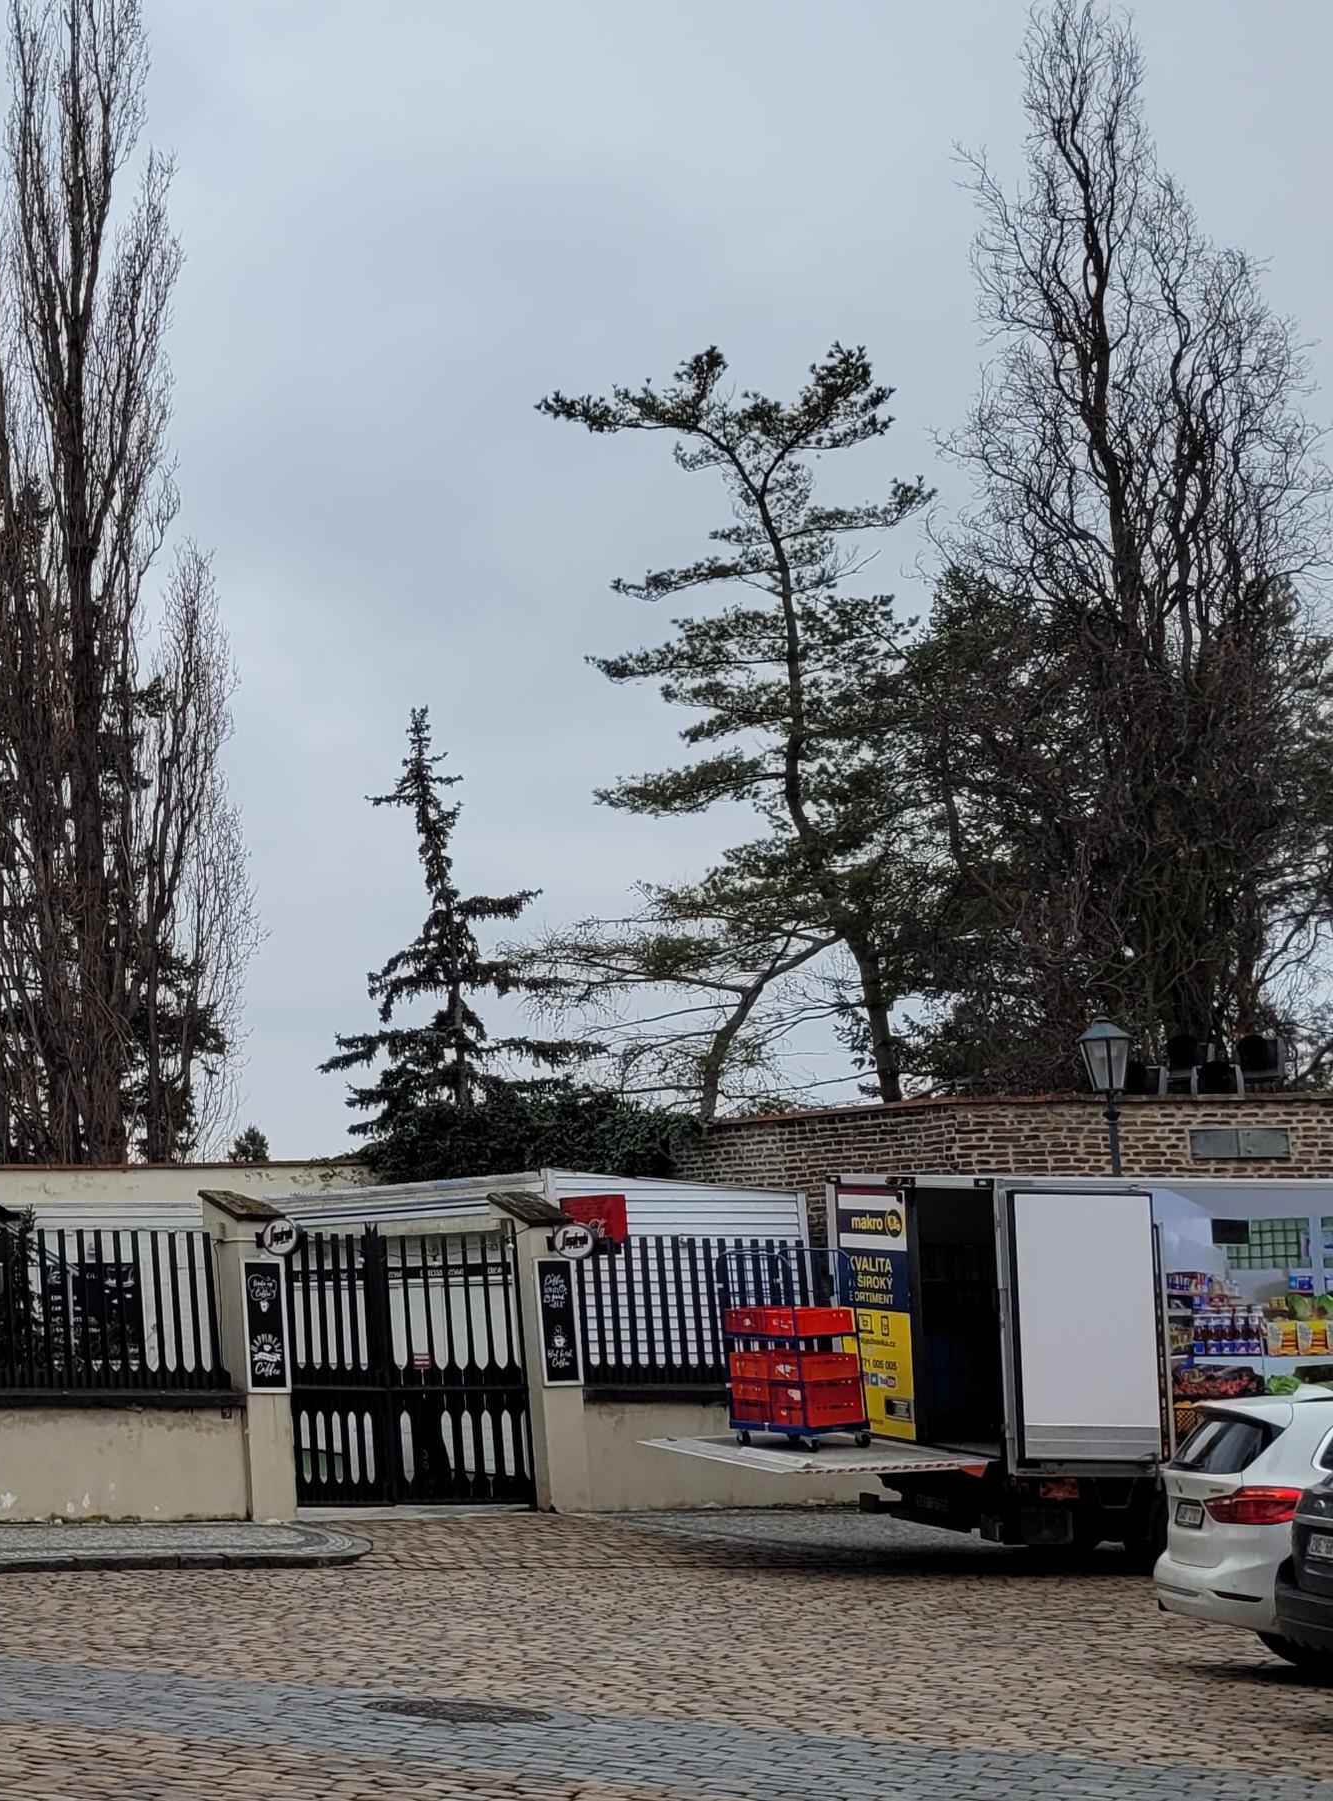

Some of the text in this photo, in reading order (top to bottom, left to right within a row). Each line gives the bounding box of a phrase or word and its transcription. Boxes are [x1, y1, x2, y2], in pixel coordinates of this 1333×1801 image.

[851, 1213, 884, 1231] makro
[857, 1272, 893, 1290] ŠIROKÝ
[255, 1361, 281, 1378] Coffee
